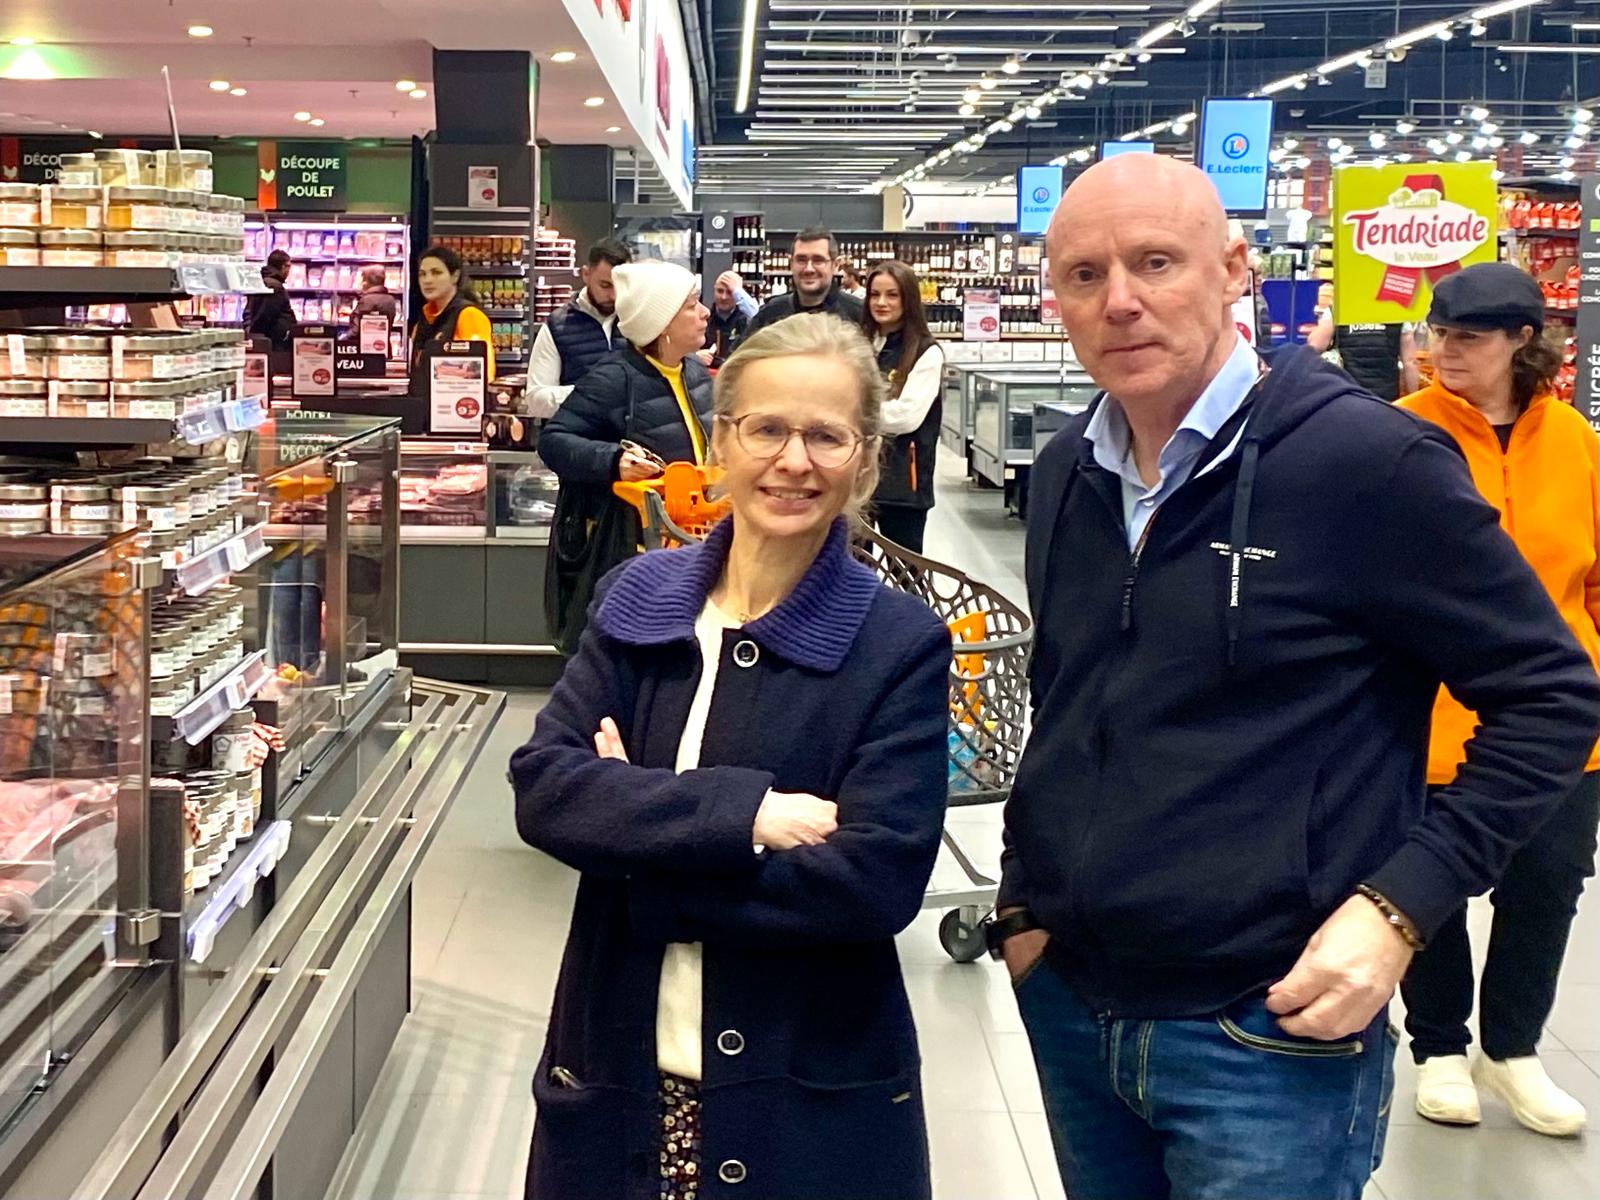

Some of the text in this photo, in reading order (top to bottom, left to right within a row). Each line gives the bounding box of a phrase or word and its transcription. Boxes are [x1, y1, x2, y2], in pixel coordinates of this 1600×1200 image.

[23, 151, 59, 166] DÉCO
[281, 154, 340, 169] DÉCOUPE
[1207, 164, 1264, 174] E.Leclerc
[302, 171, 319, 183] DE
[287, 185, 335, 198] POULET
[1408, 251, 1438, 262] Veau
[337, 345, 358, 355] LLES
